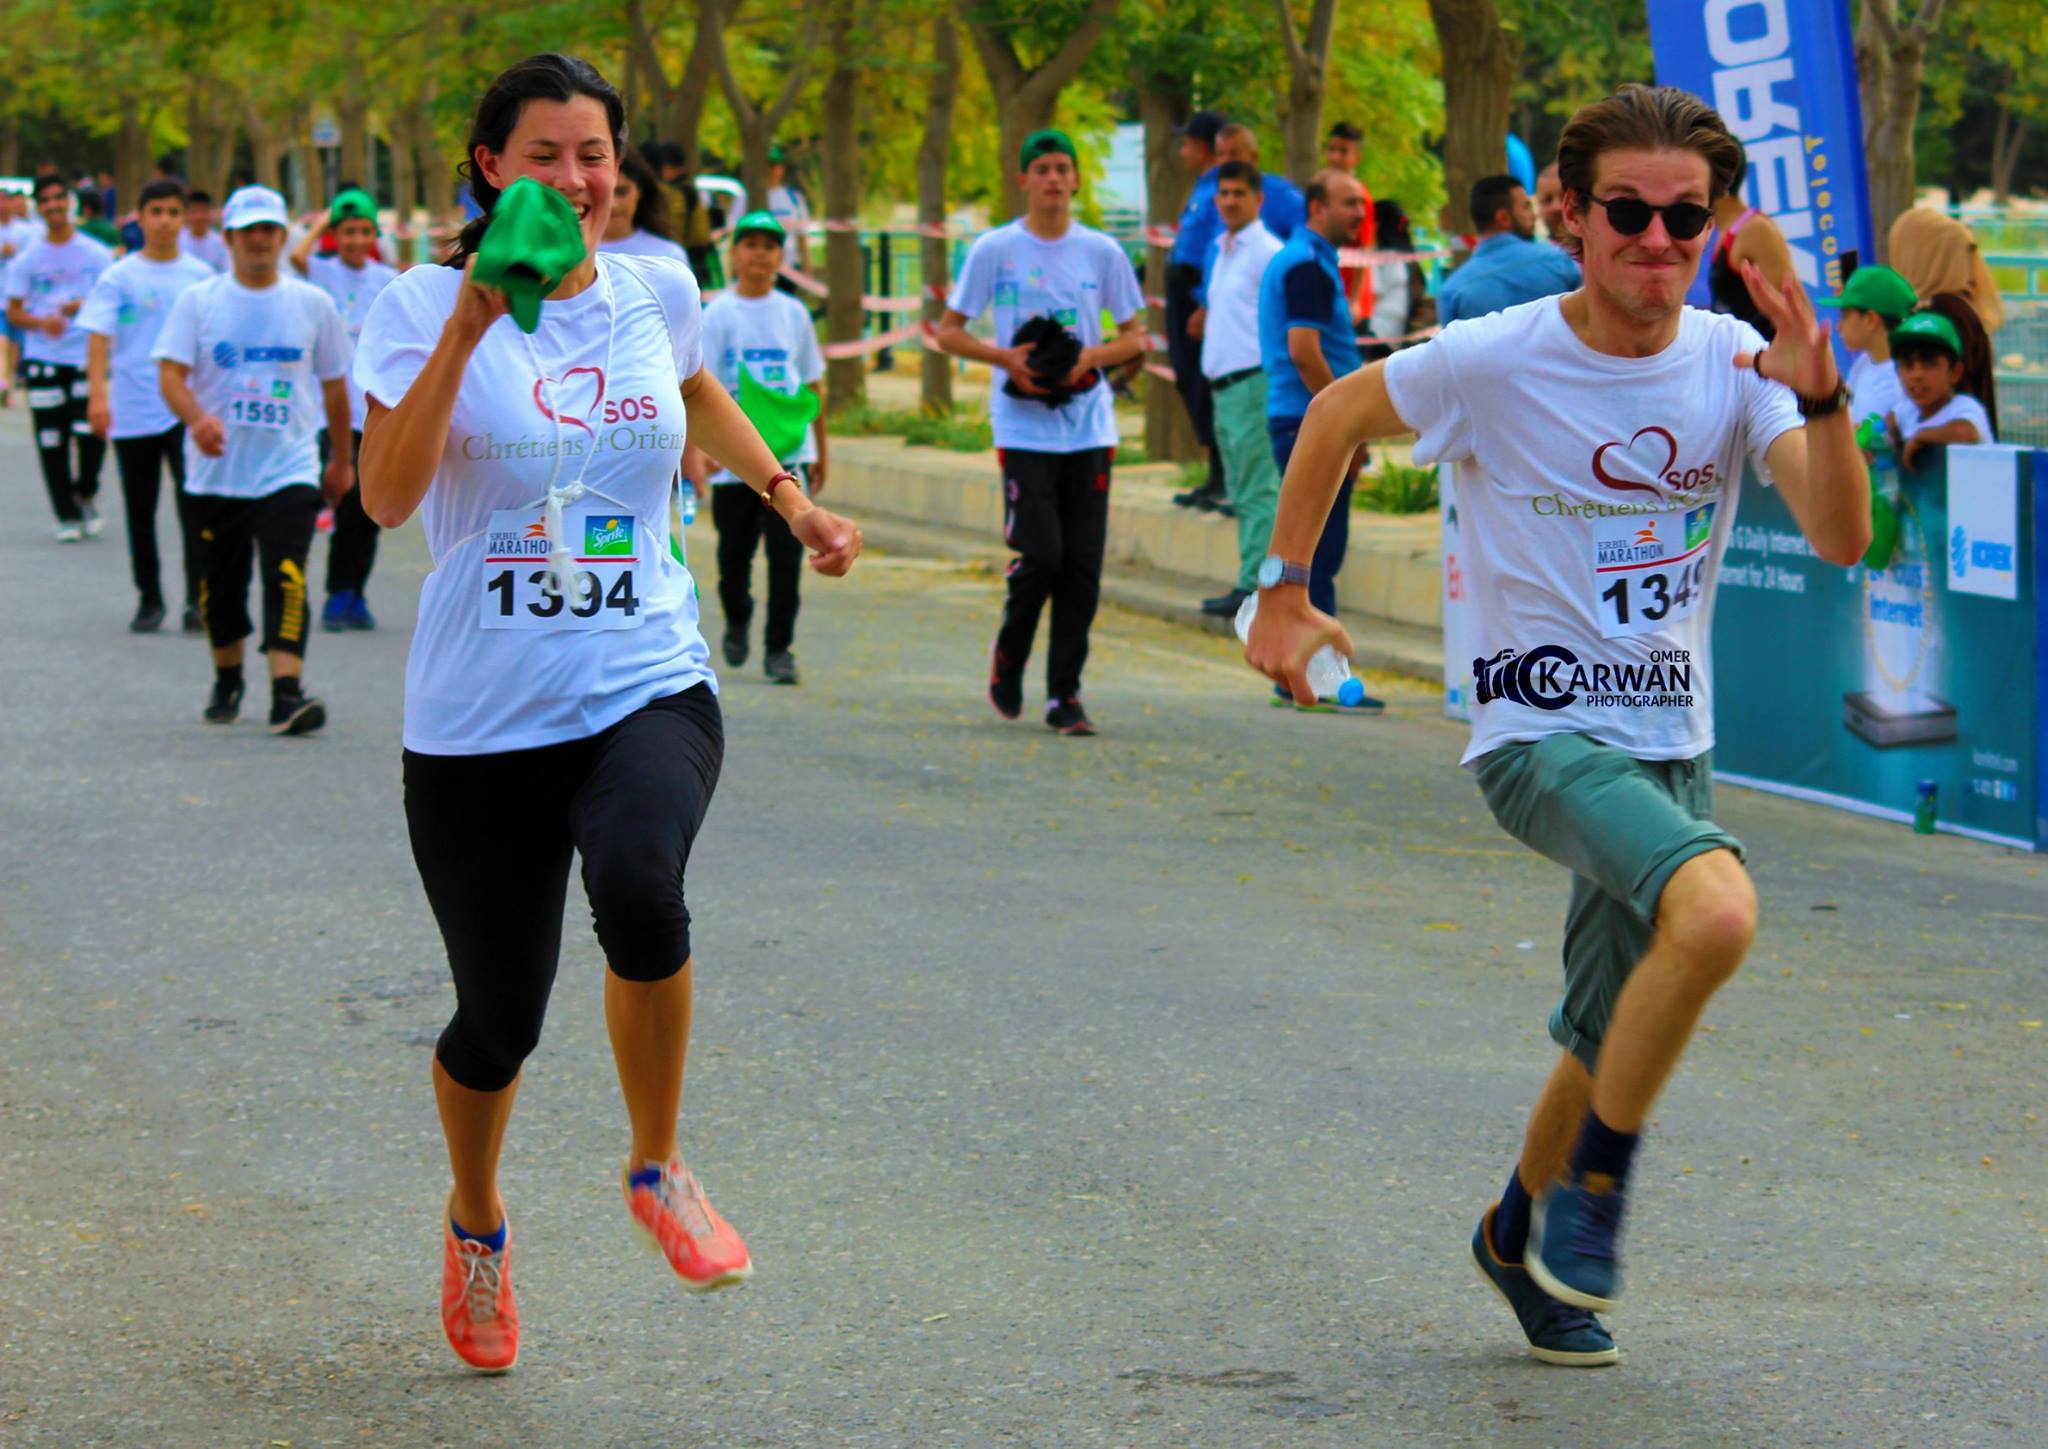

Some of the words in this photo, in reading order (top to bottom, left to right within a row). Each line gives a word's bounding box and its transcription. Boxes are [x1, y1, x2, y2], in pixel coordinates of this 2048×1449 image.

[233, 400, 289, 425] 1593
[603, 396, 658, 424] SOS
[462, 433, 584, 461] Chrétiens
[1666, 464, 1714, 490] SOS
[1532, 493, 1658, 519] Chrétiens
[592, 525, 626, 548] Sprite
[1598, 540, 1629, 551] ERBIL
[1597, 544, 1665, 564] MARATHON
[487, 570, 640, 618] 1394
